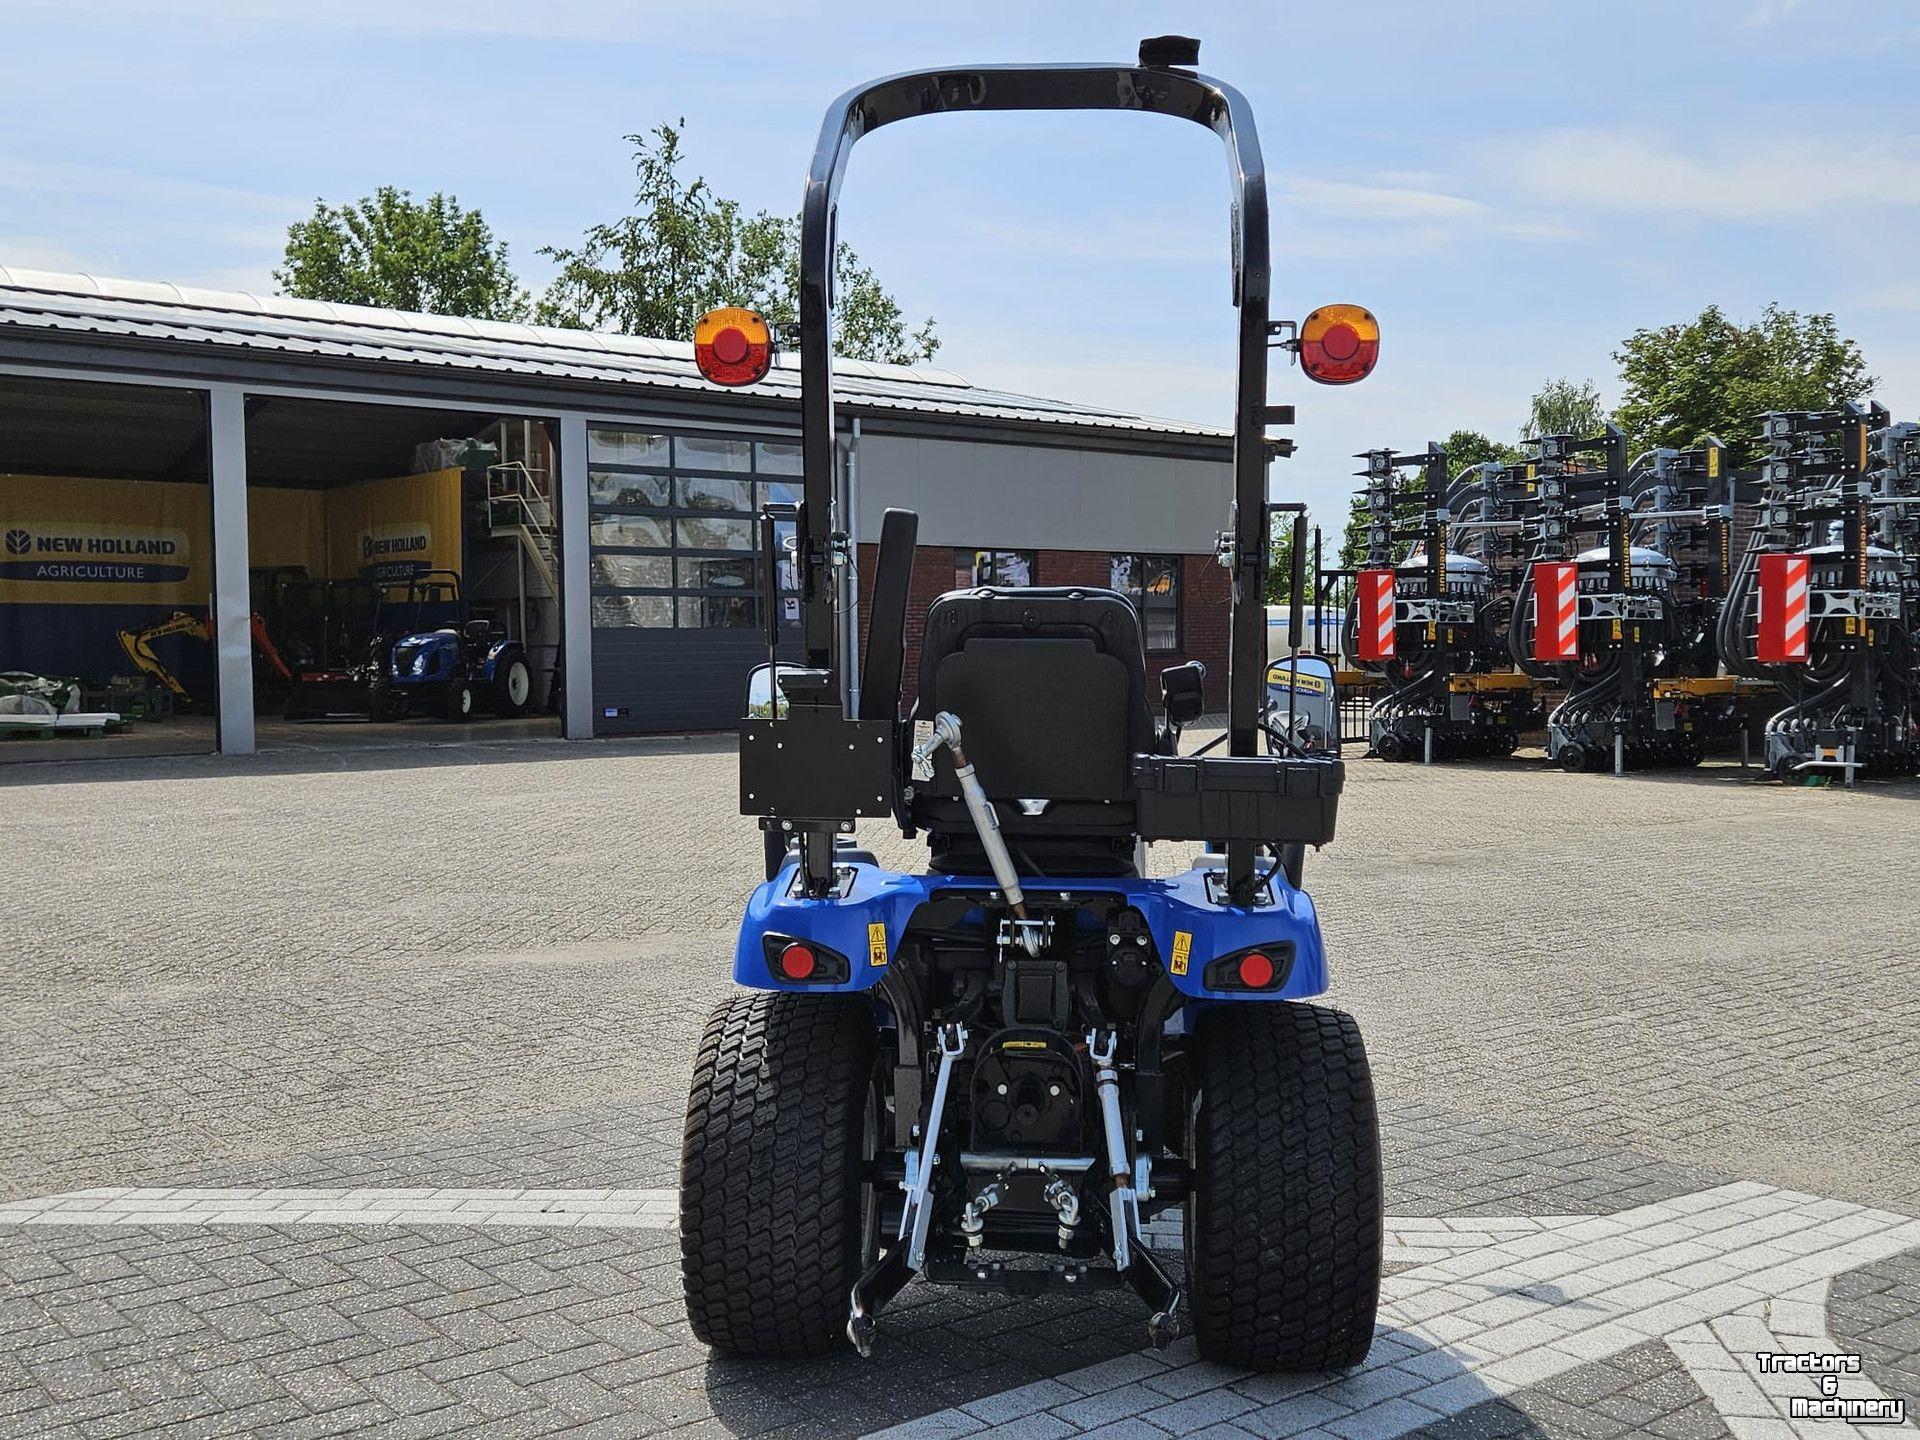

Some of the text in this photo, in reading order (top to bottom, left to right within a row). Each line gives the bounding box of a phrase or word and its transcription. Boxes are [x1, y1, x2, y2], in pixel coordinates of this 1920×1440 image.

[37, 537, 176, 555] NEW HOLLAND
[375, 536, 426, 554] NEW HOLLAND
[37, 565, 145, 579] AGRICULTURE
